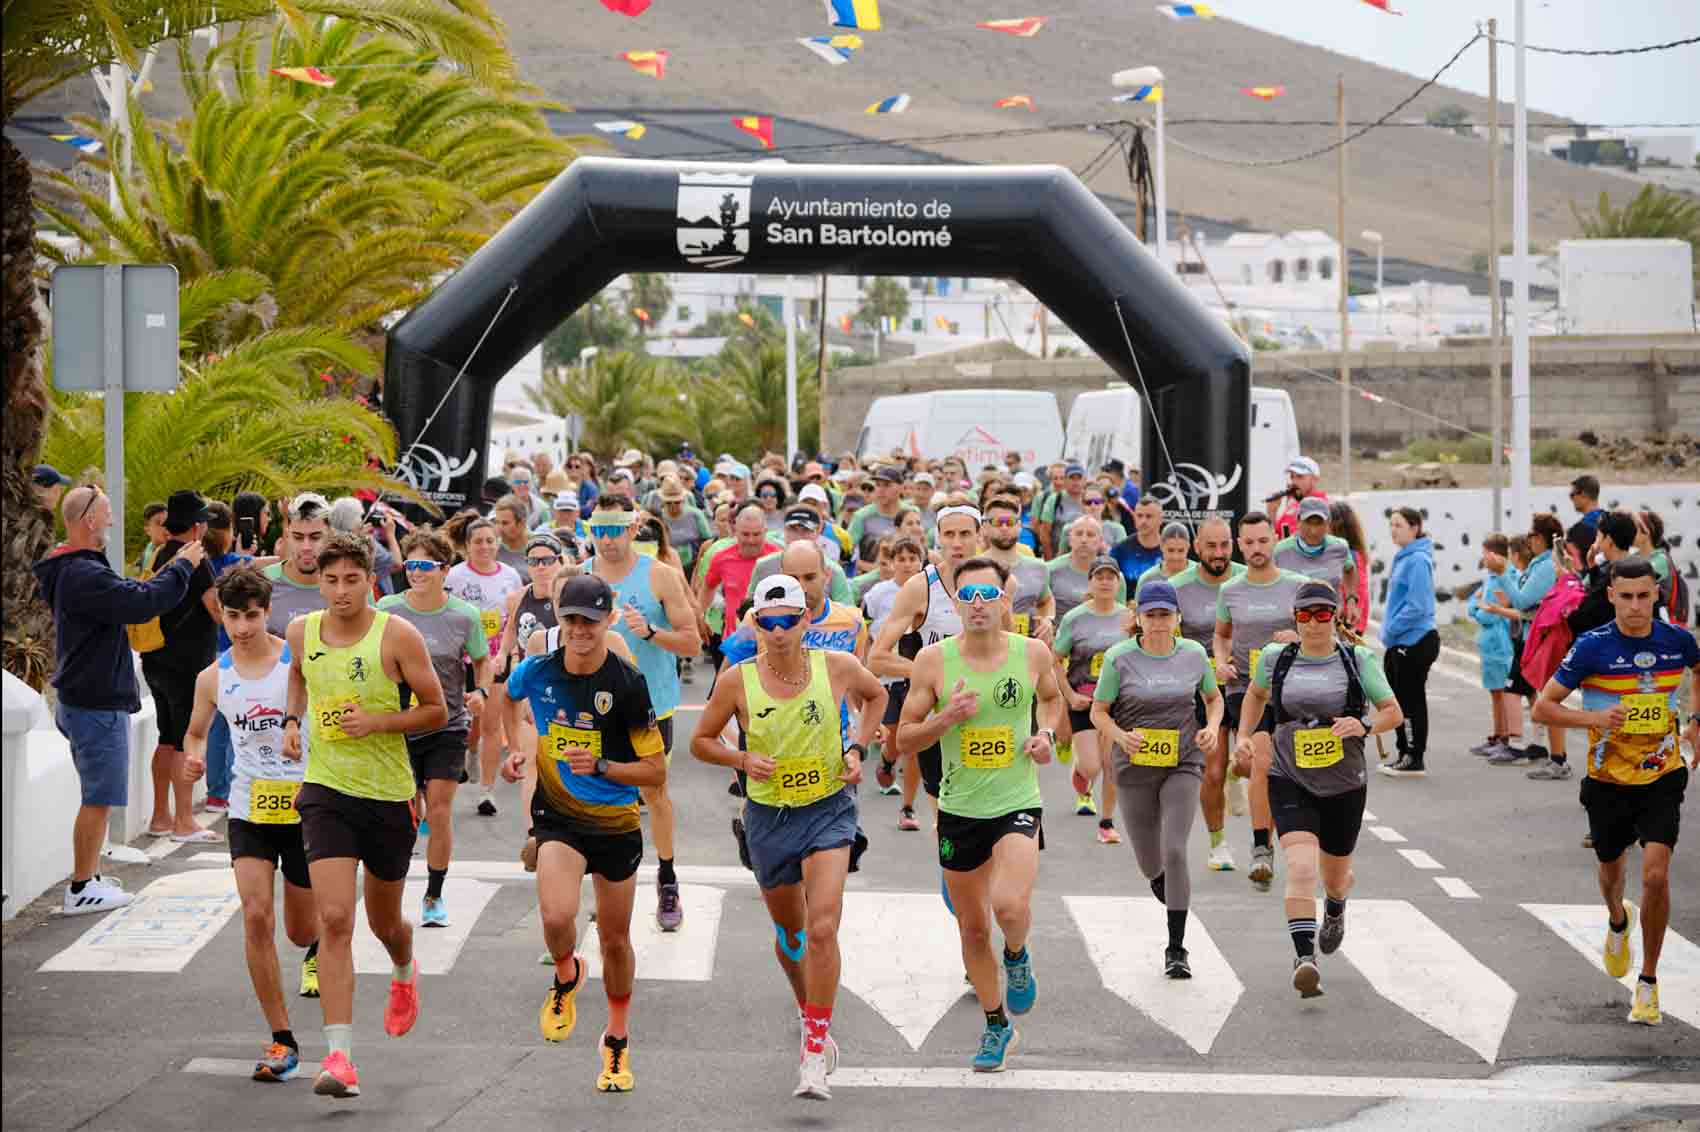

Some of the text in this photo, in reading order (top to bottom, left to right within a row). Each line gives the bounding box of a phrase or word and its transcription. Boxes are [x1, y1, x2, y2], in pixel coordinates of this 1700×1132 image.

[767, 196, 952, 220] Ayuntamiento de
[767, 222, 952, 247] San Bartolomé
[1628, 706, 1661, 721] 248
[969, 741, 1006, 756] 226
[1139, 741, 1171, 755] 240
[1303, 741, 1336, 756] 222
[782, 769, 820, 788] 228
[256, 794, 292, 810] 235
